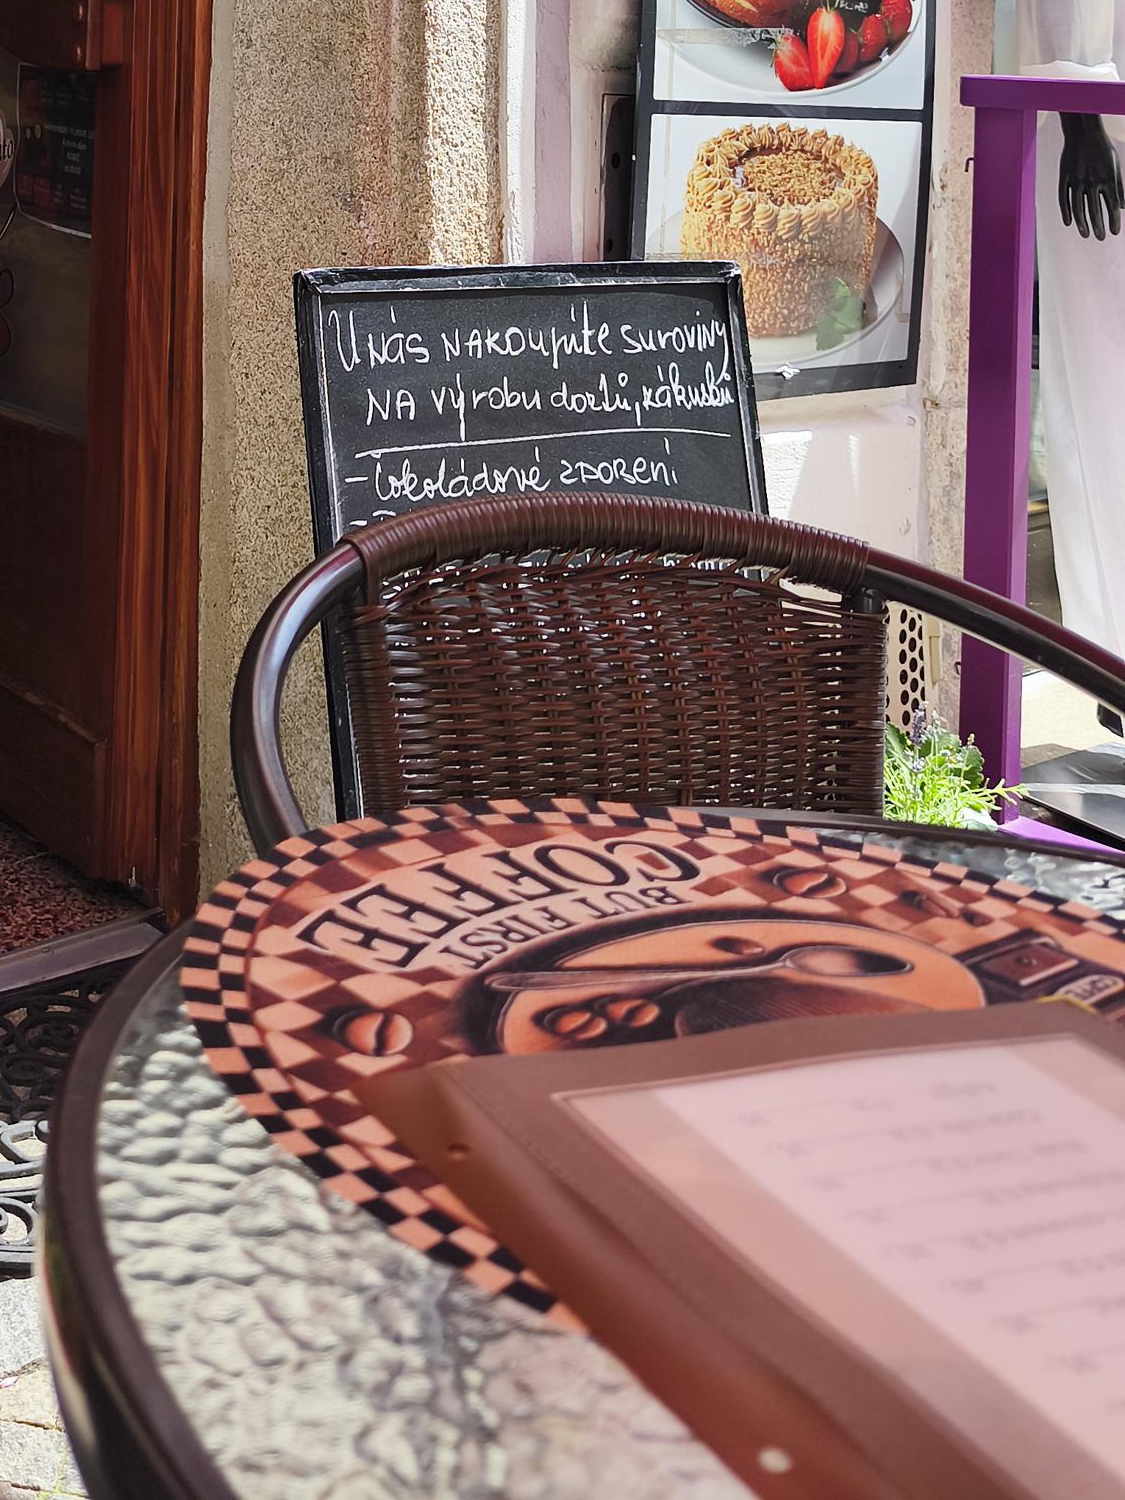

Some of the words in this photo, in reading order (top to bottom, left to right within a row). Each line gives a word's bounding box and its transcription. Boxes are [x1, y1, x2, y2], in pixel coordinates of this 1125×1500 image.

[328, 309, 362, 372] U
[366, 387, 416, 426] NA
[431, 373, 542, 442] výrobu
[295, 839, 701, 968] COFFEE
[571, 885, 692, 919] BUT
[438, 904, 574, 967] FIRST
